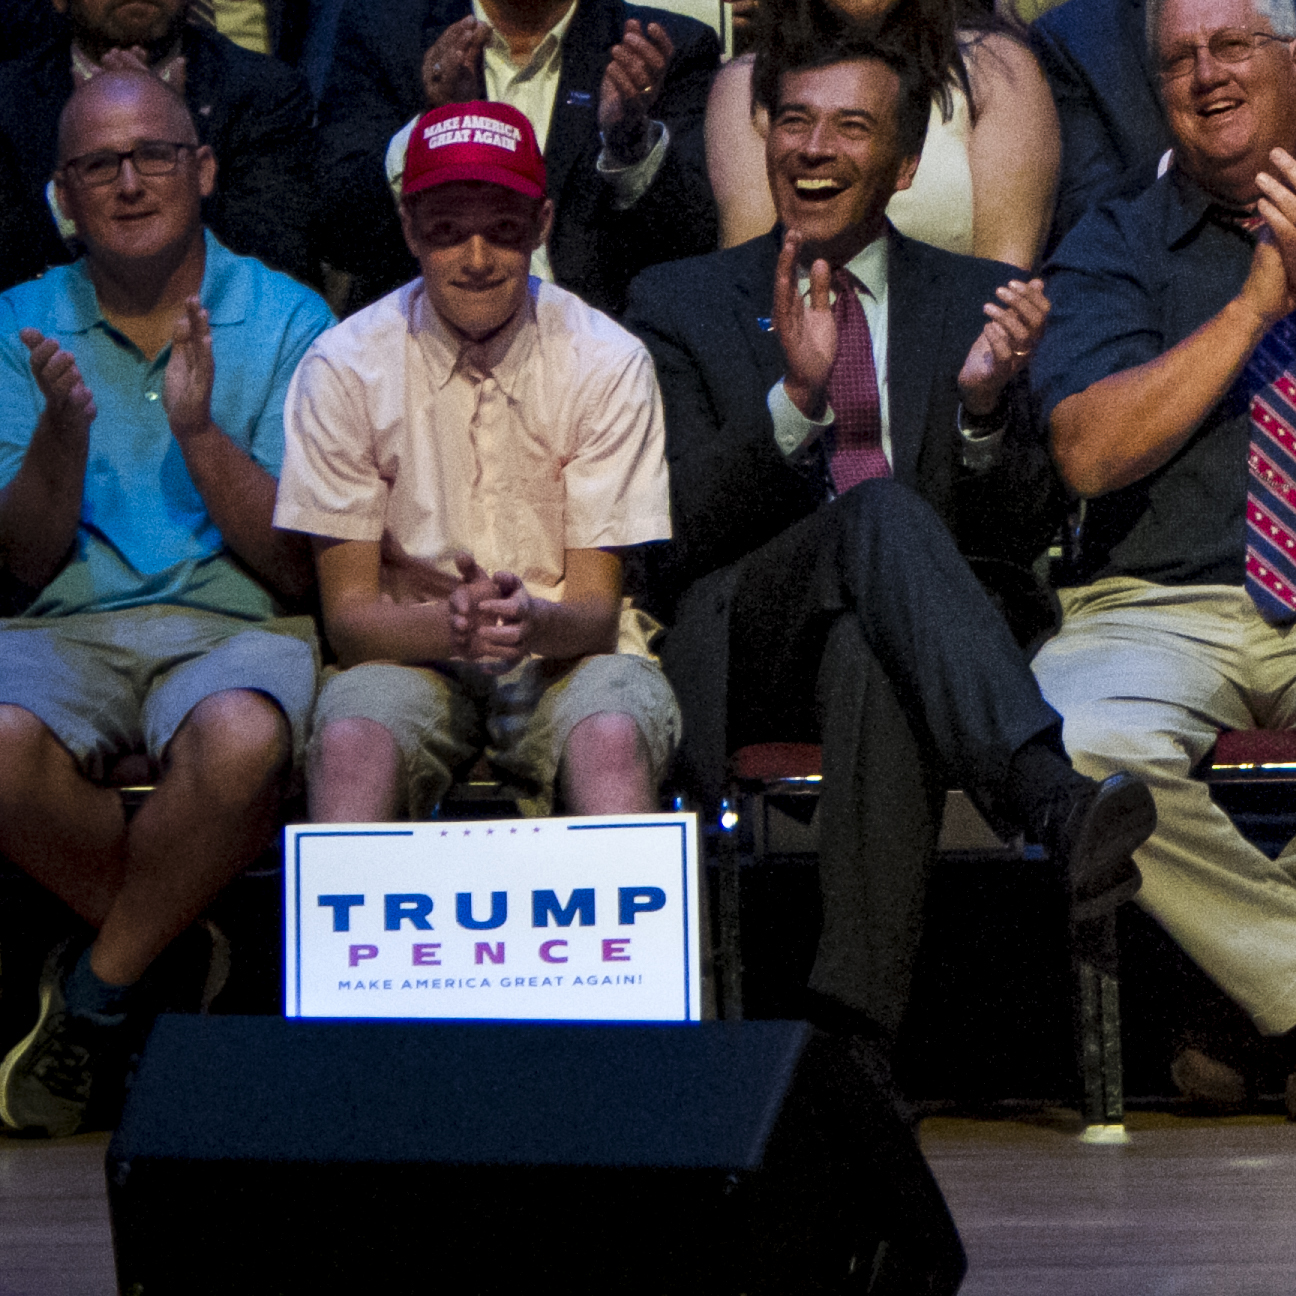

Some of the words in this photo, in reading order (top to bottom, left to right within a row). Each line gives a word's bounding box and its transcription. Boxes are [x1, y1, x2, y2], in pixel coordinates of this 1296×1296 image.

[423, 116, 461, 140] MAKE
[461, 115, 522, 141] AMERICA
[428, 129, 472, 150] GREAT
[473, 129, 517, 153] AGAIN
[317, 886, 667, 933] TRUMP
[348, 938, 631, 967] PENCE
[338, 979, 393, 990] MAKE
[401, 978, 492, 990] AMERICA
[500, 975, 564, 988] GREAT
[572, 974, 643, 986] AGAIN!
